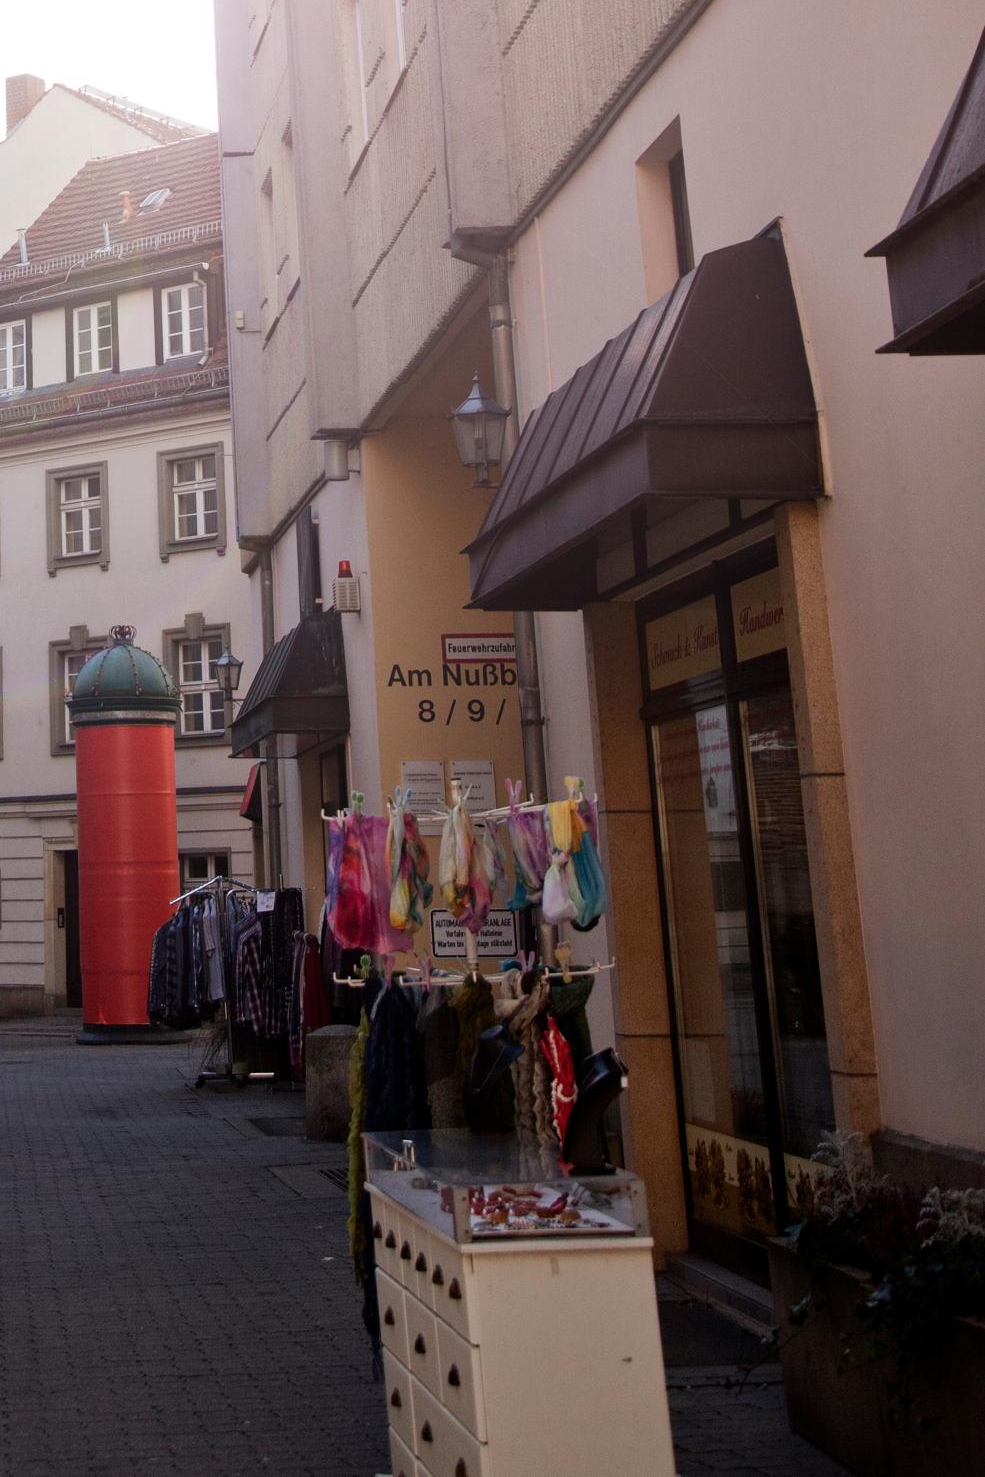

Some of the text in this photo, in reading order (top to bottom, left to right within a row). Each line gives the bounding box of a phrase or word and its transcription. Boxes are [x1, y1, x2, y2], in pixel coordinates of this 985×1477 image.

[739, 600, 785, 636] Handwer
[447, 642, 517, 654] Feuerwehrzufahr
[388, 663, 517, 687] Am Nußb
[418, 699, 436, 723] 8
[467, 698, 485, 722] 9
